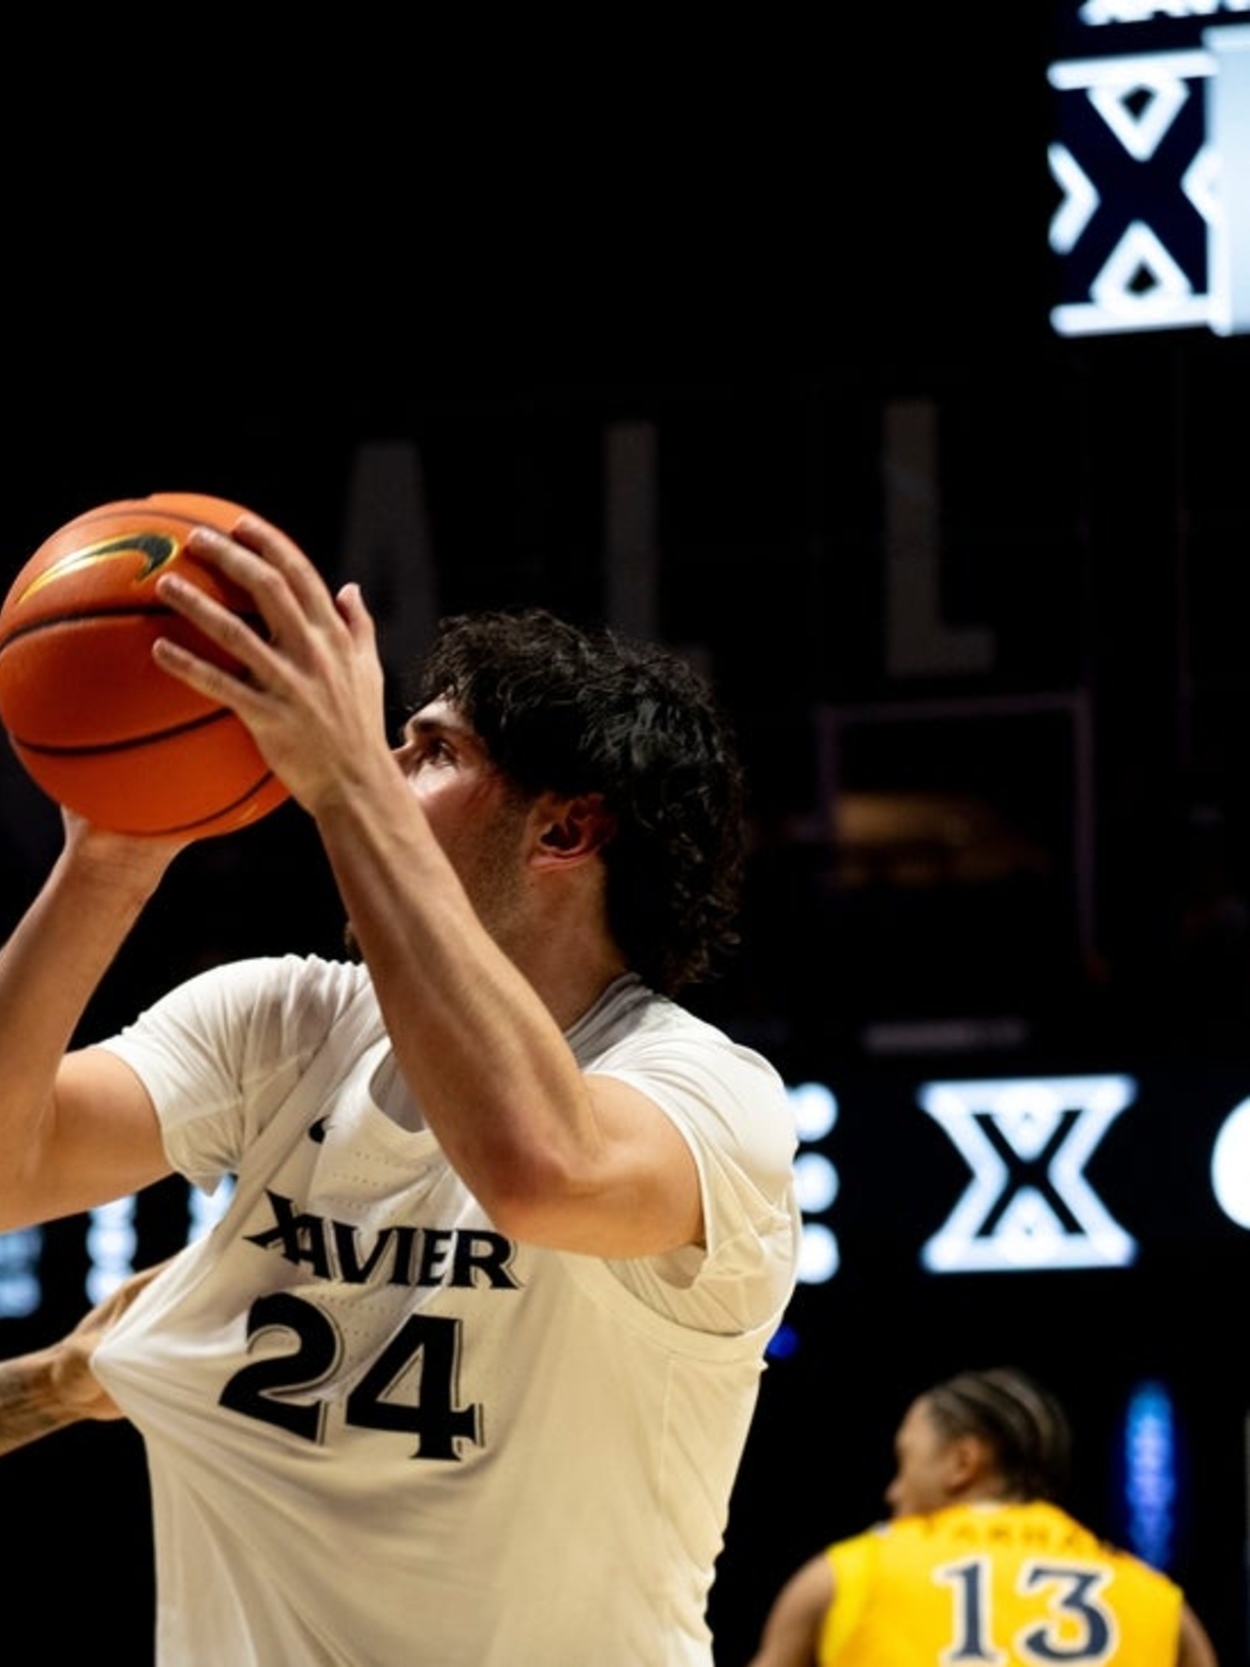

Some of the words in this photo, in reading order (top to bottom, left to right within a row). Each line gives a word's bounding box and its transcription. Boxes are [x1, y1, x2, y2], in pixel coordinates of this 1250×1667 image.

[243, 1188, 526, 1290] XAVIER
[218, 1292, 485, 1461] 24
[932, 1553, 1121, 1667] 13
